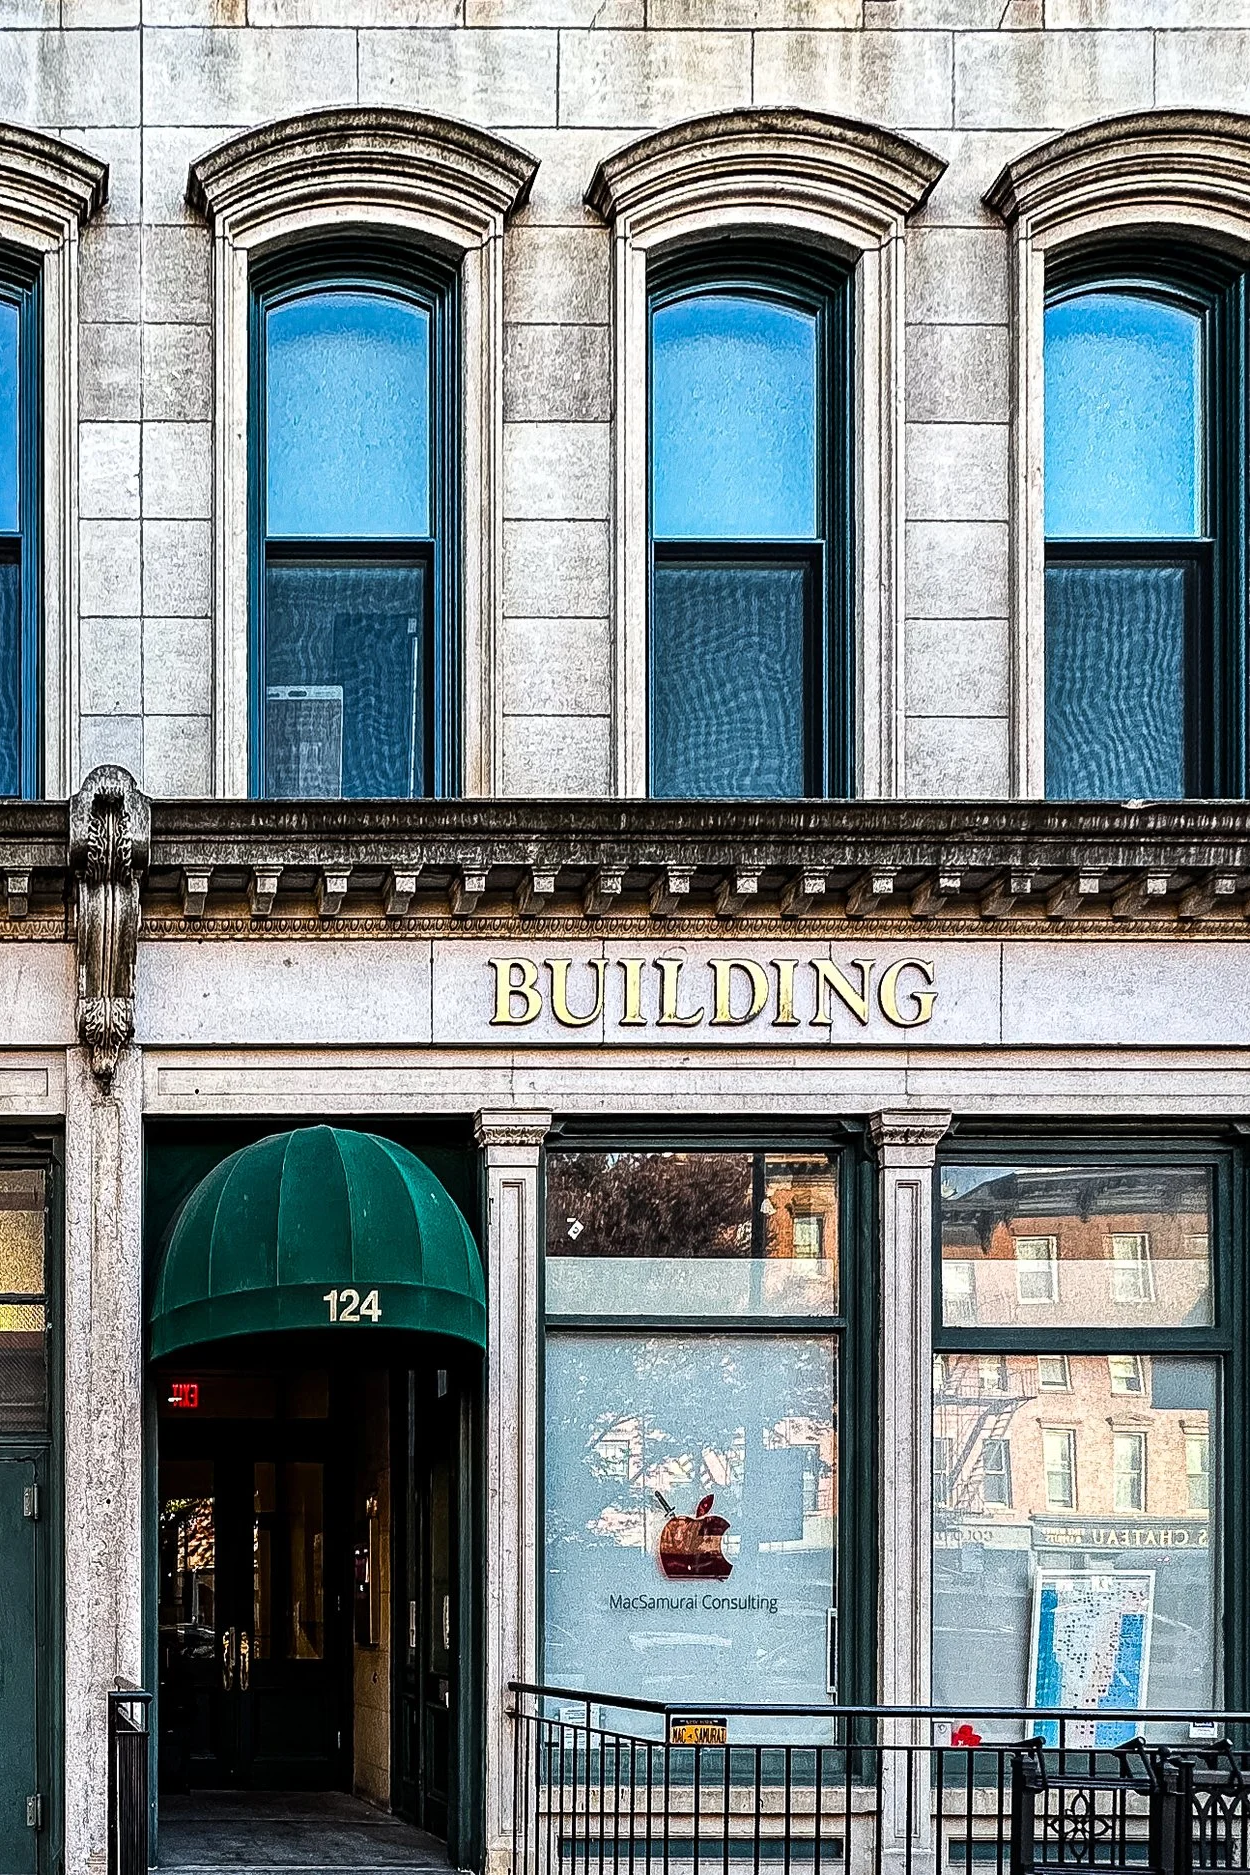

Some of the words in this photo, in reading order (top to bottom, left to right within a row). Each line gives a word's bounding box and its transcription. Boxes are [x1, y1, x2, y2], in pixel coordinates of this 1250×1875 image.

[488, 957, 940, 1028] BUILDING
[323, 1288, 382, 1322] 124
[609, 1594, 698, 1609] MacSamurai
[702, 1594, 778, 1613] Consulting
